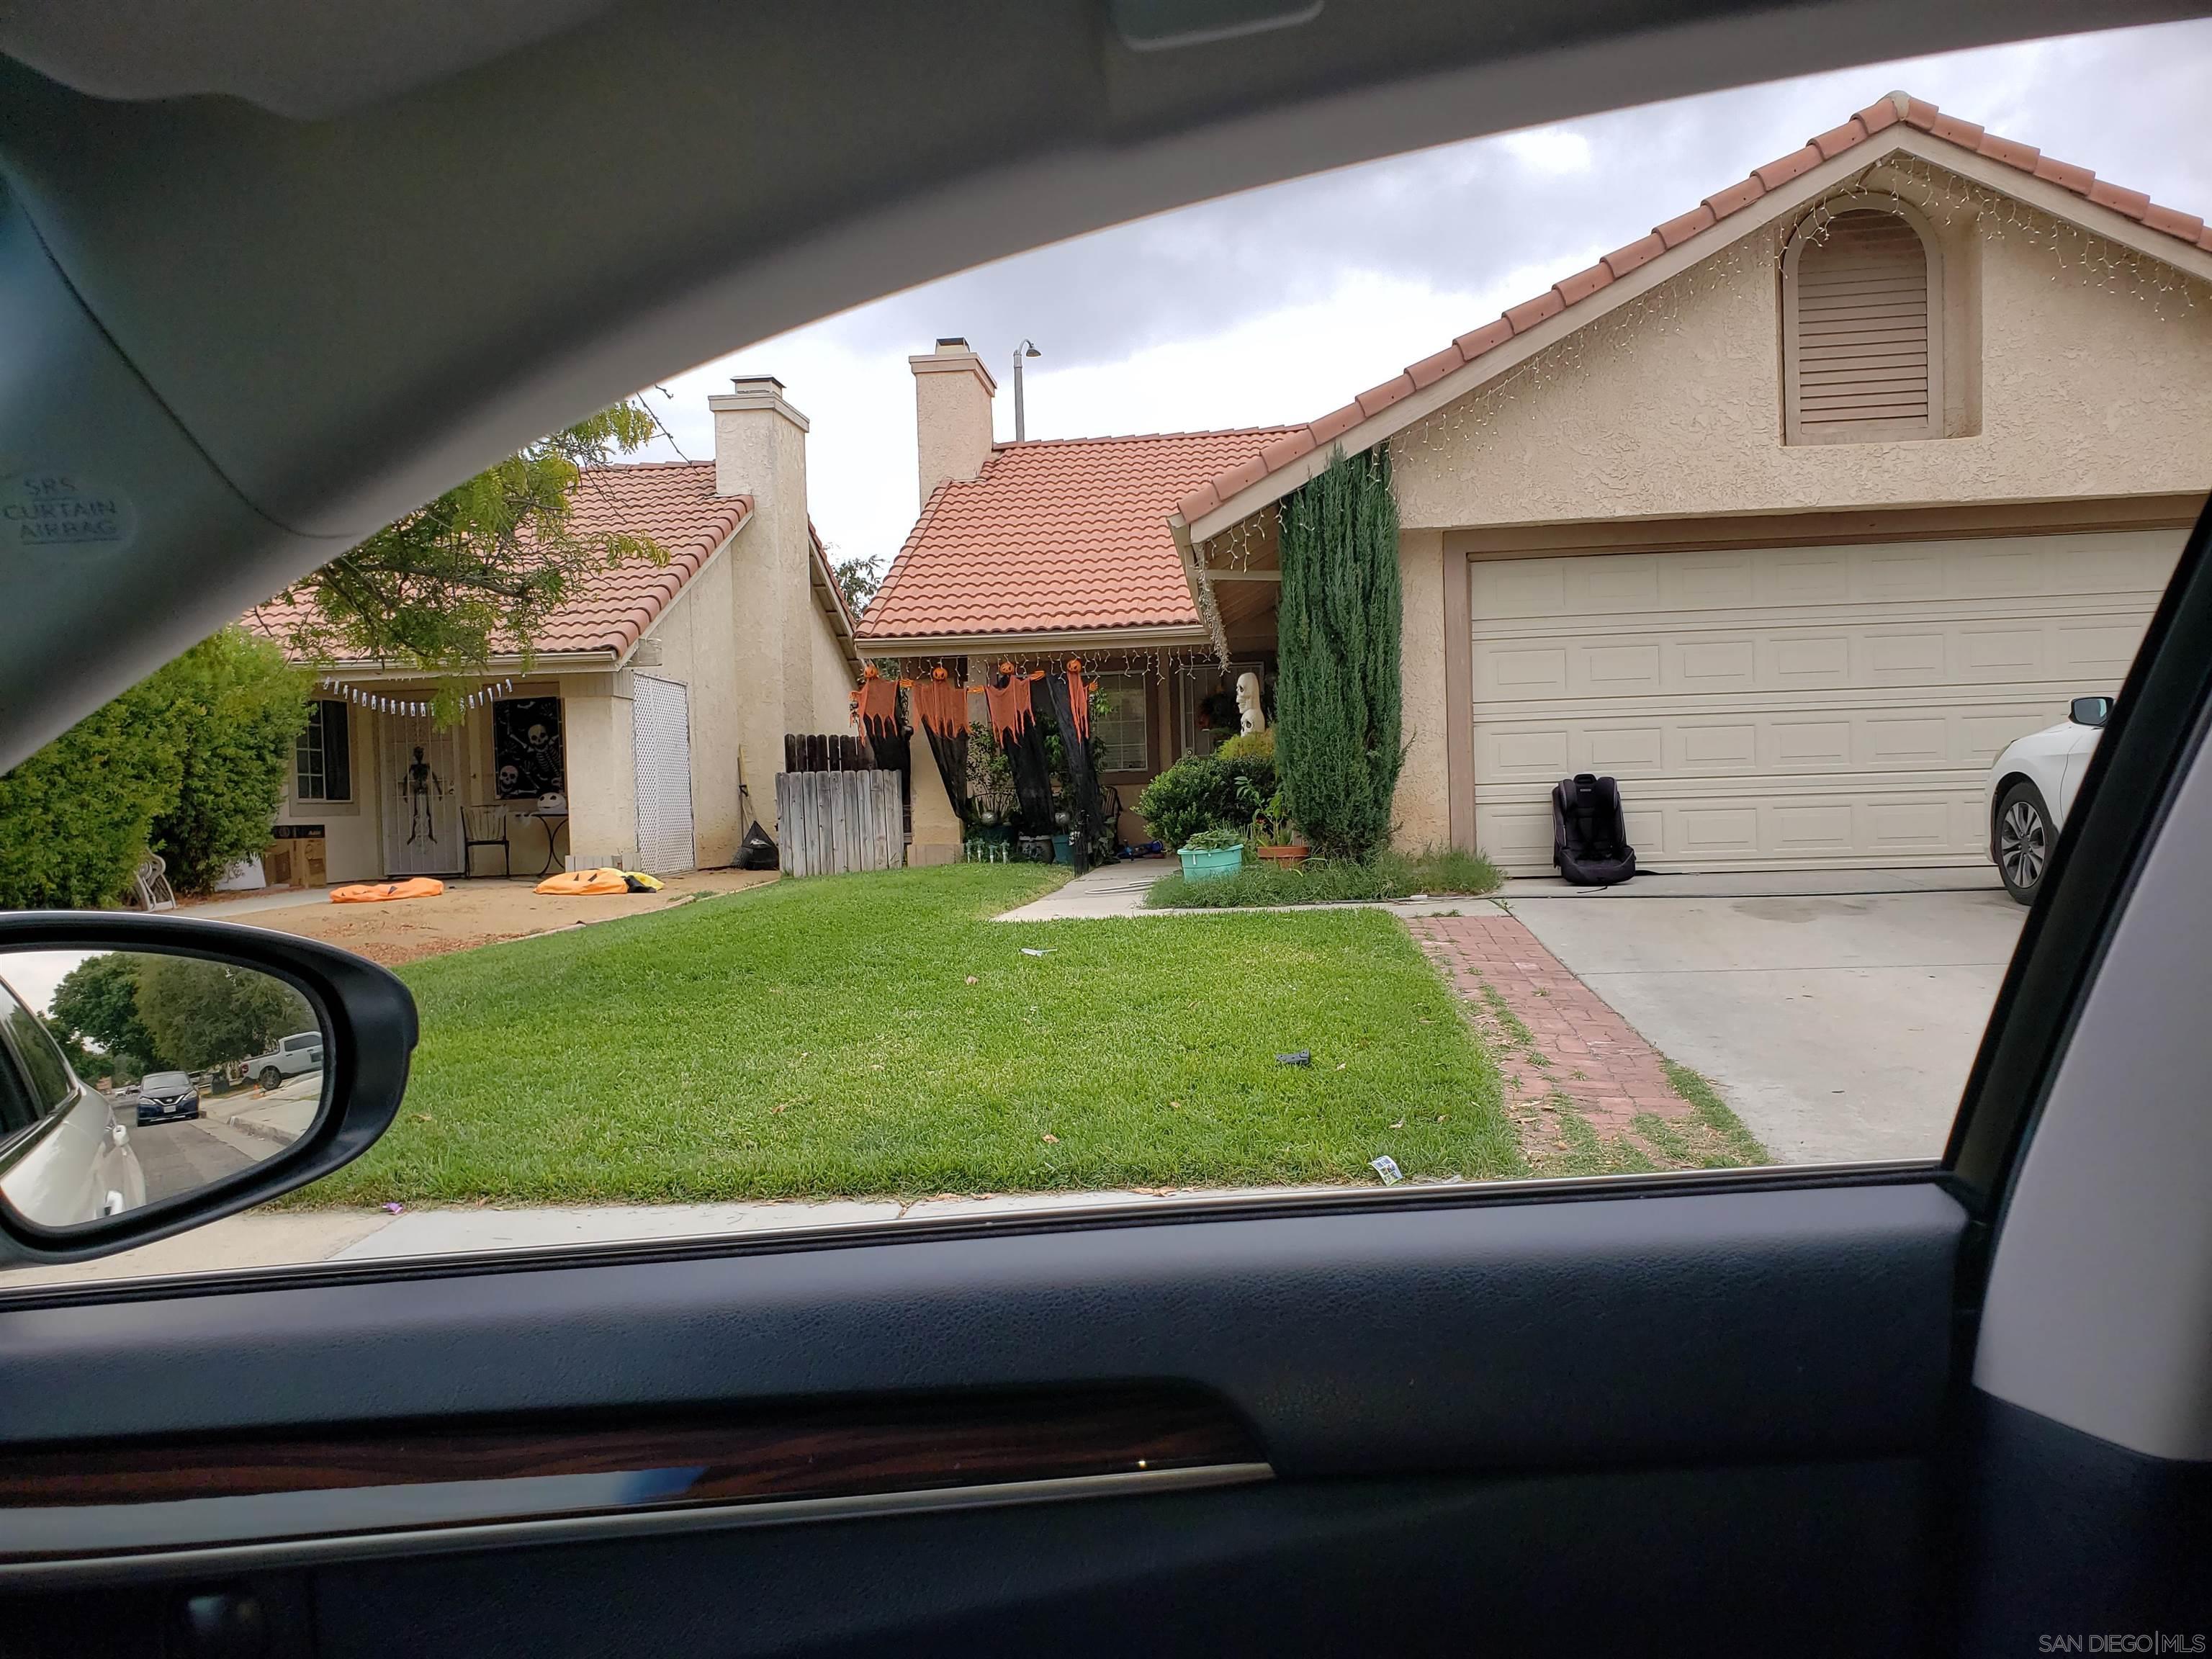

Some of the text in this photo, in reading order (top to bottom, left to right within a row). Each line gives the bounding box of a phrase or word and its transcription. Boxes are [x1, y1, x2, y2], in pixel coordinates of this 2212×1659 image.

[24, 477, 77, 496] SRS
[3, 500, 118, 521] CURTAIN
[20, 521, 118, 539] AIRBAG
